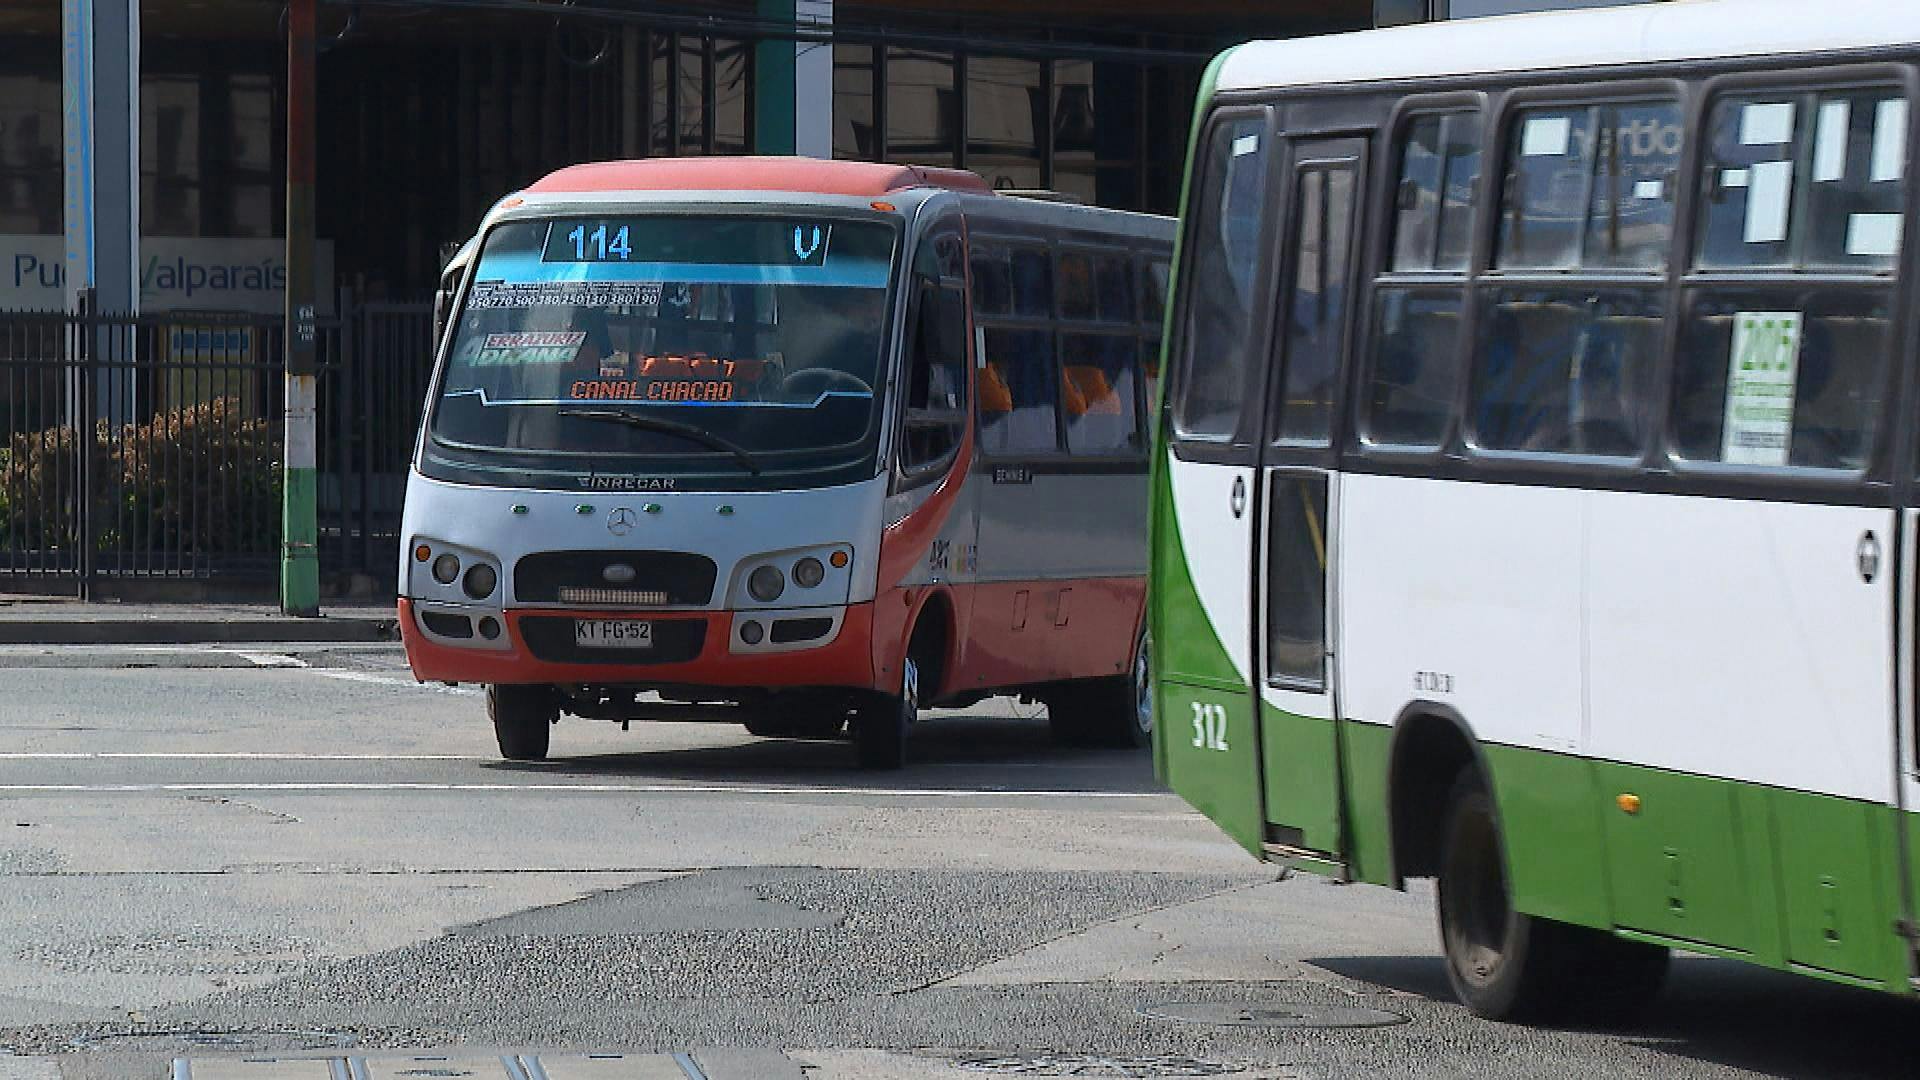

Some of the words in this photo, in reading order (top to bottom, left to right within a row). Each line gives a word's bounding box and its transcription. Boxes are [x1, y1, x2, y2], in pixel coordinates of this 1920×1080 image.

[569, 225, 631, 260] 114
[570, 381, 642, 399] CANAL
[1191, 701, 1230, 750] 312
